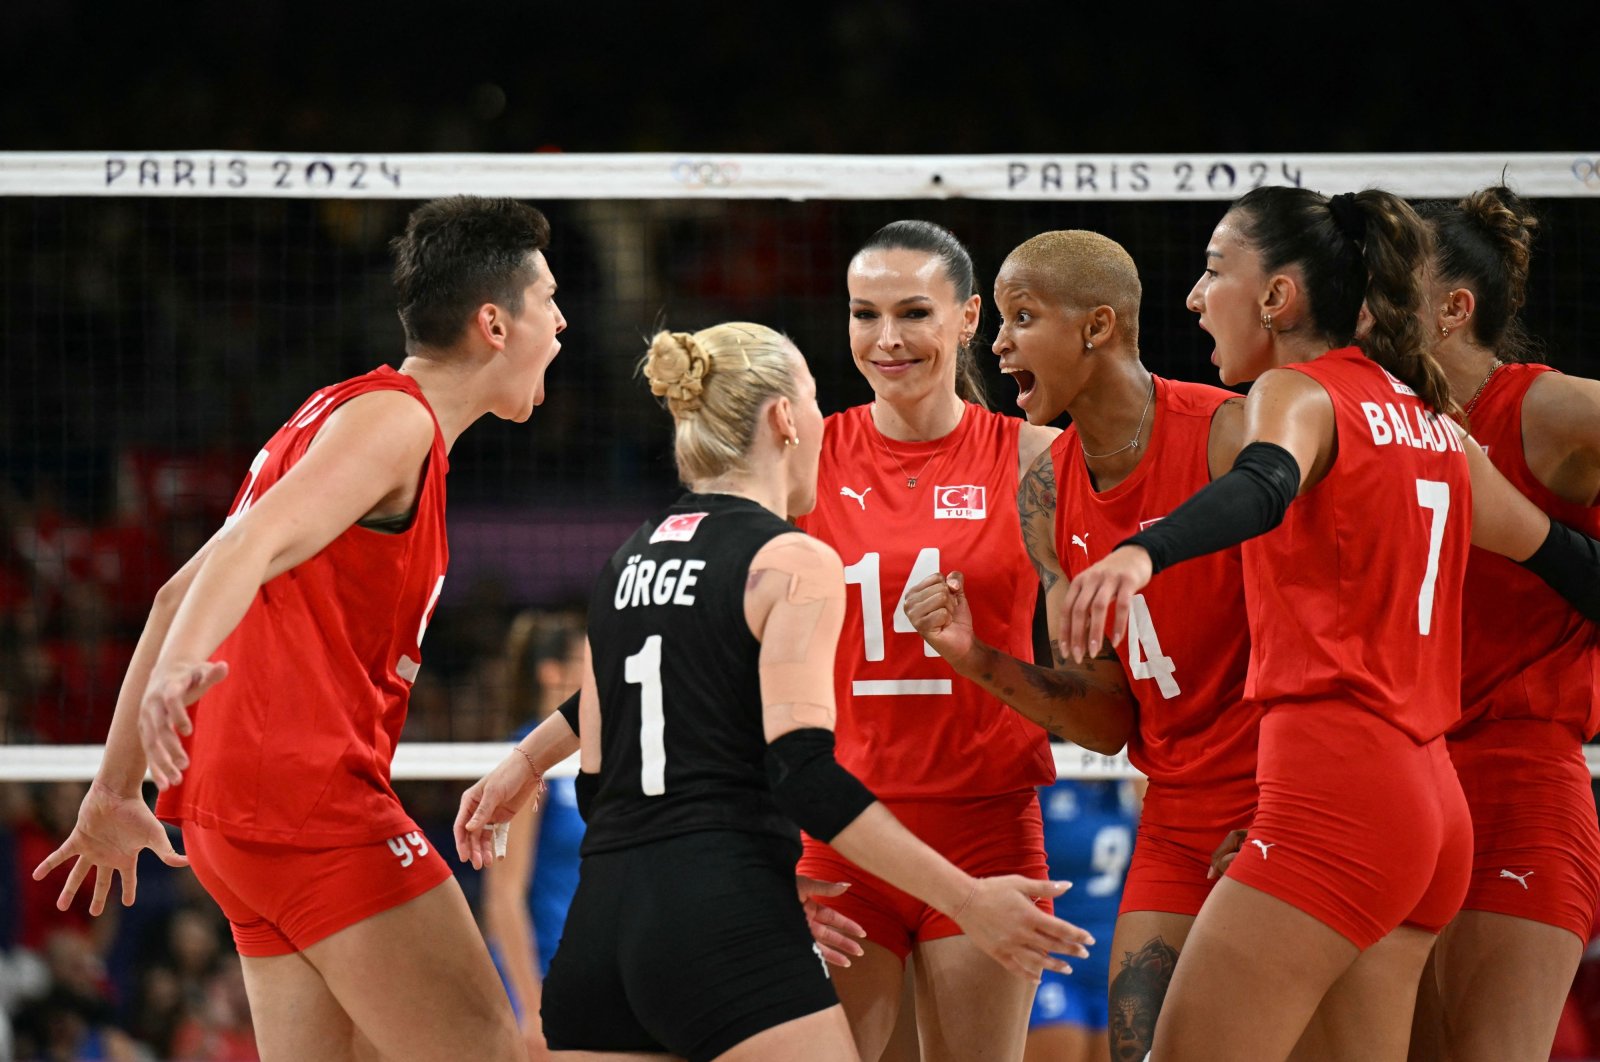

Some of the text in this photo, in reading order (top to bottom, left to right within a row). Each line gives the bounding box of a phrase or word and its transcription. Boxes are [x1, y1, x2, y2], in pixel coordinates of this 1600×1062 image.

[105, 158, 402, 190] PARIS 2024
[1007, 161, 1302, 192] PARIS 2024
[945, 509, 973, 517] TUR
[614, 554, 707, 611] ÖRGE
[1415, 478, 1451, 636] 7
[844, 547, 942, 662] 14
[1128, 593, 1182, 700] 4
[624, 633, 667, 797] 1
[1086, 825, 1132, 897] 9
